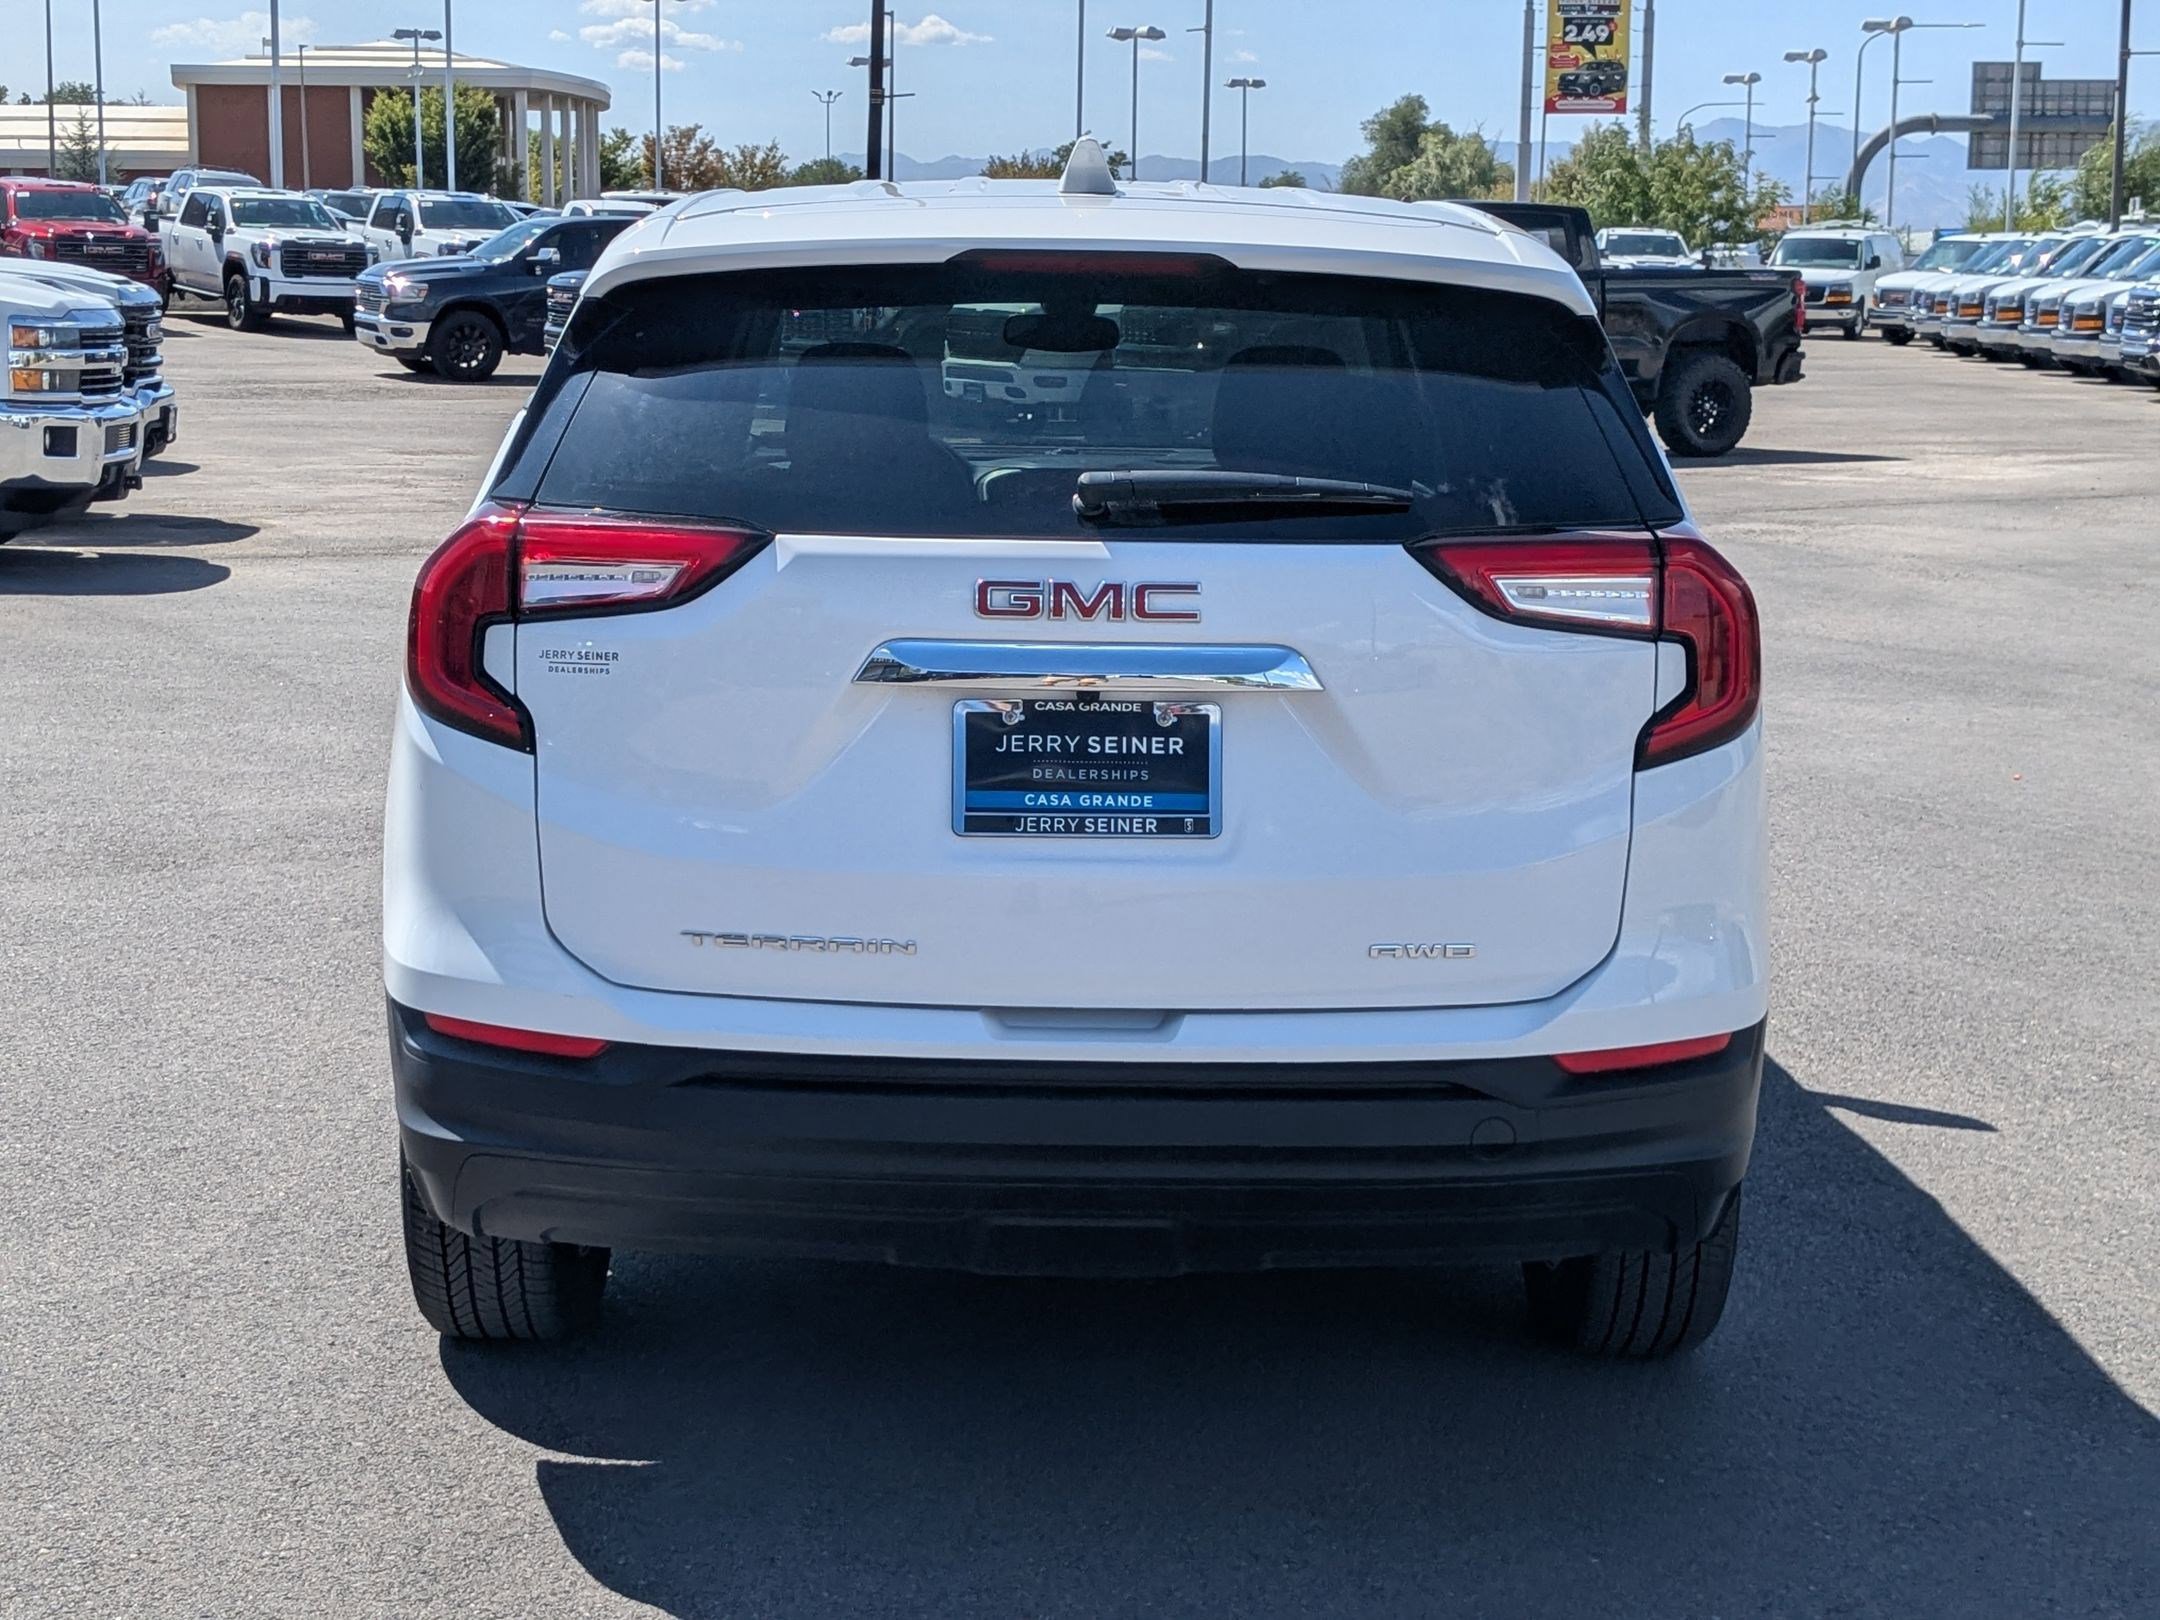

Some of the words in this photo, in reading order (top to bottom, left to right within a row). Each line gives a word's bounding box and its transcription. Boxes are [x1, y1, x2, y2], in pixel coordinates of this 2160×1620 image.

[1563, 24, 1610, 42] 2.49
[975, 579, 1201, 623] GMC
[539, 650, 575, 660] JERRY
[577, 651, 619, 661] SEINER
[548, 666, 610, 675] DEALERSHIPS
[1034, 701, 1075, 712] CASA
[1078, 702, 1142, 713] GRANDE
[996, 735, 1081, 753] JERRY
[1087, 736, 1184, 755] SEINER
[1032, 769, 1150, 782] DEALERSHIPS
[1024, 793, 1072, 806] CASA
[1079, 795, 1153, 808] GRANDE
[1015, 817, 1079, 833] JERRY
[1084, 818, 1158, 833] SEINER
[680, 930, 918, 955] TERRAIN
[1368, 943, 1477, 959] AWD
